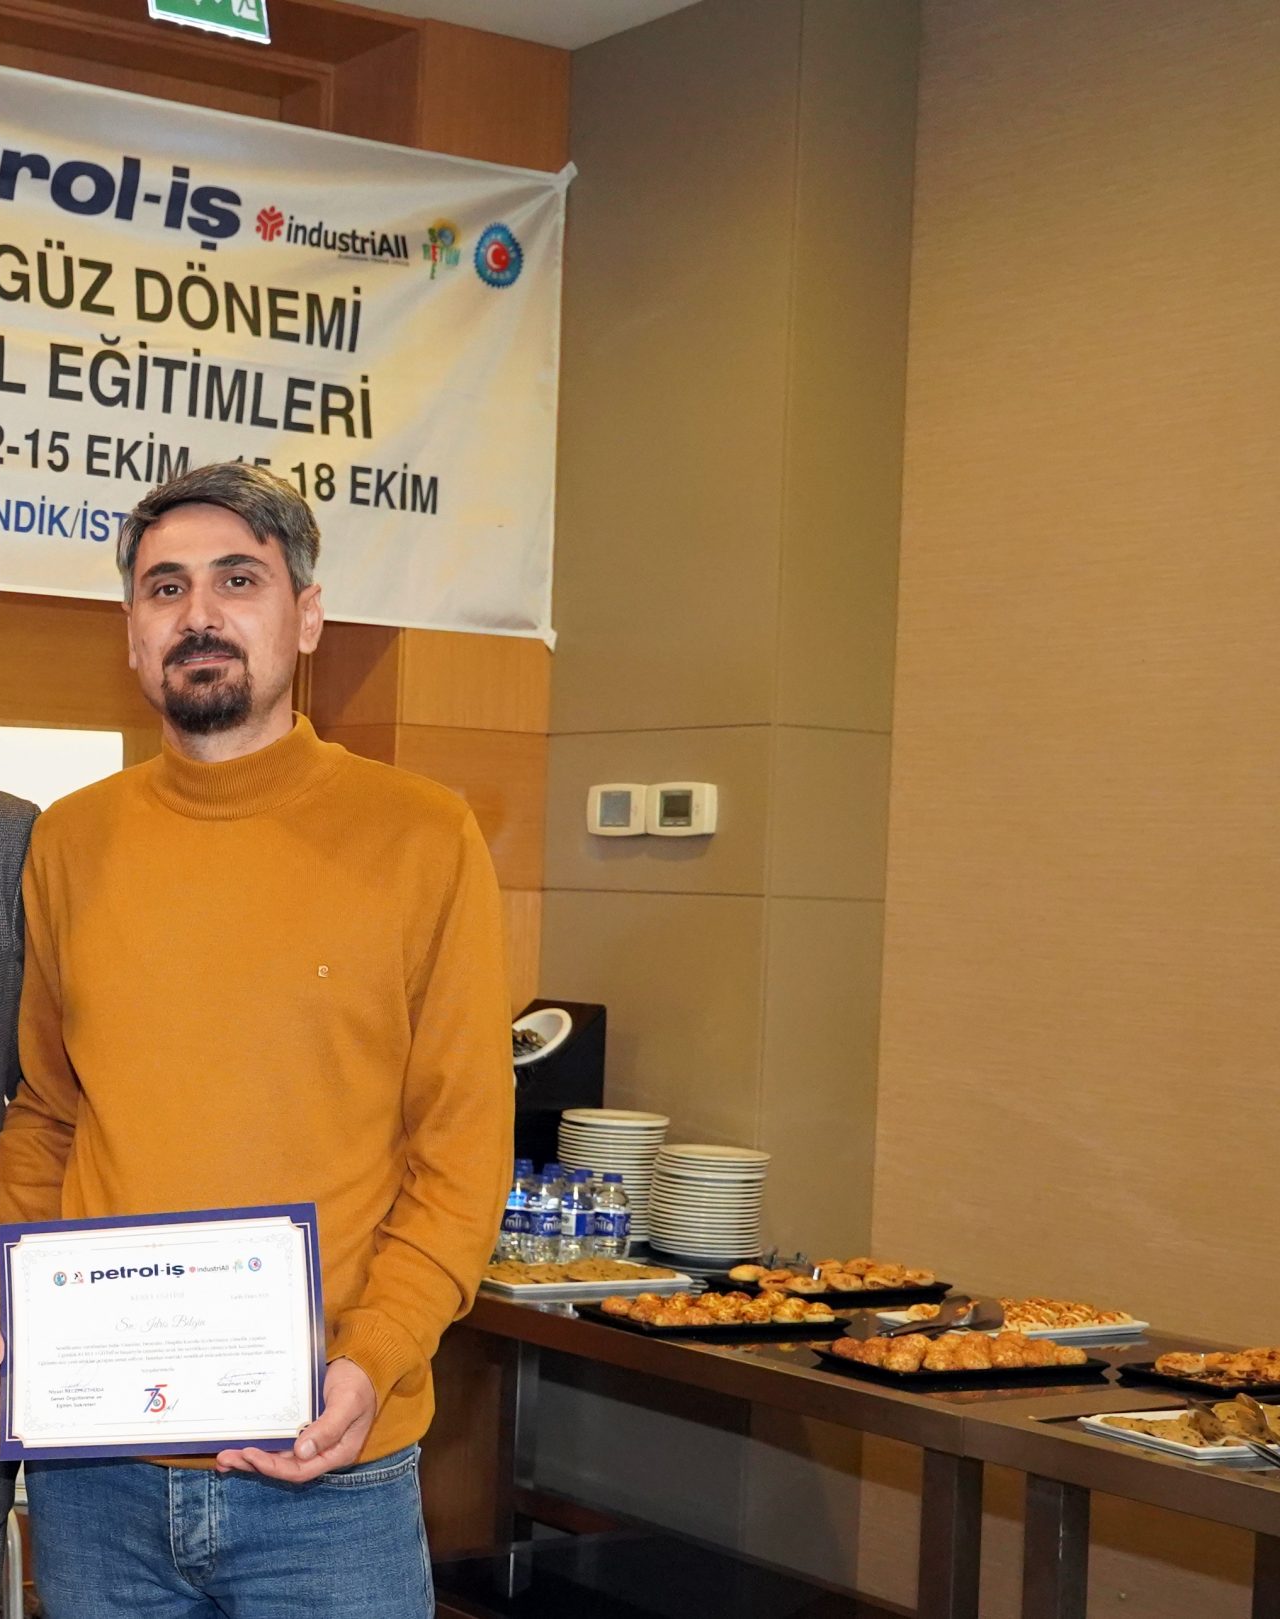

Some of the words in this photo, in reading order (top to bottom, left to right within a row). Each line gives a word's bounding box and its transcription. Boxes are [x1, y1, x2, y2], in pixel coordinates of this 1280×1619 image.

[286, 215, 409, 259] industriAll
[135, 261, 362, 353] DÖNEMİ
[49, 333, 373, 439] EĞİTİMLERİ
[86, 432, 189, 484] EKİM
[350, 462, 439, 514] EKİM
[90, 1263, 185, 1284] petrol-iş
